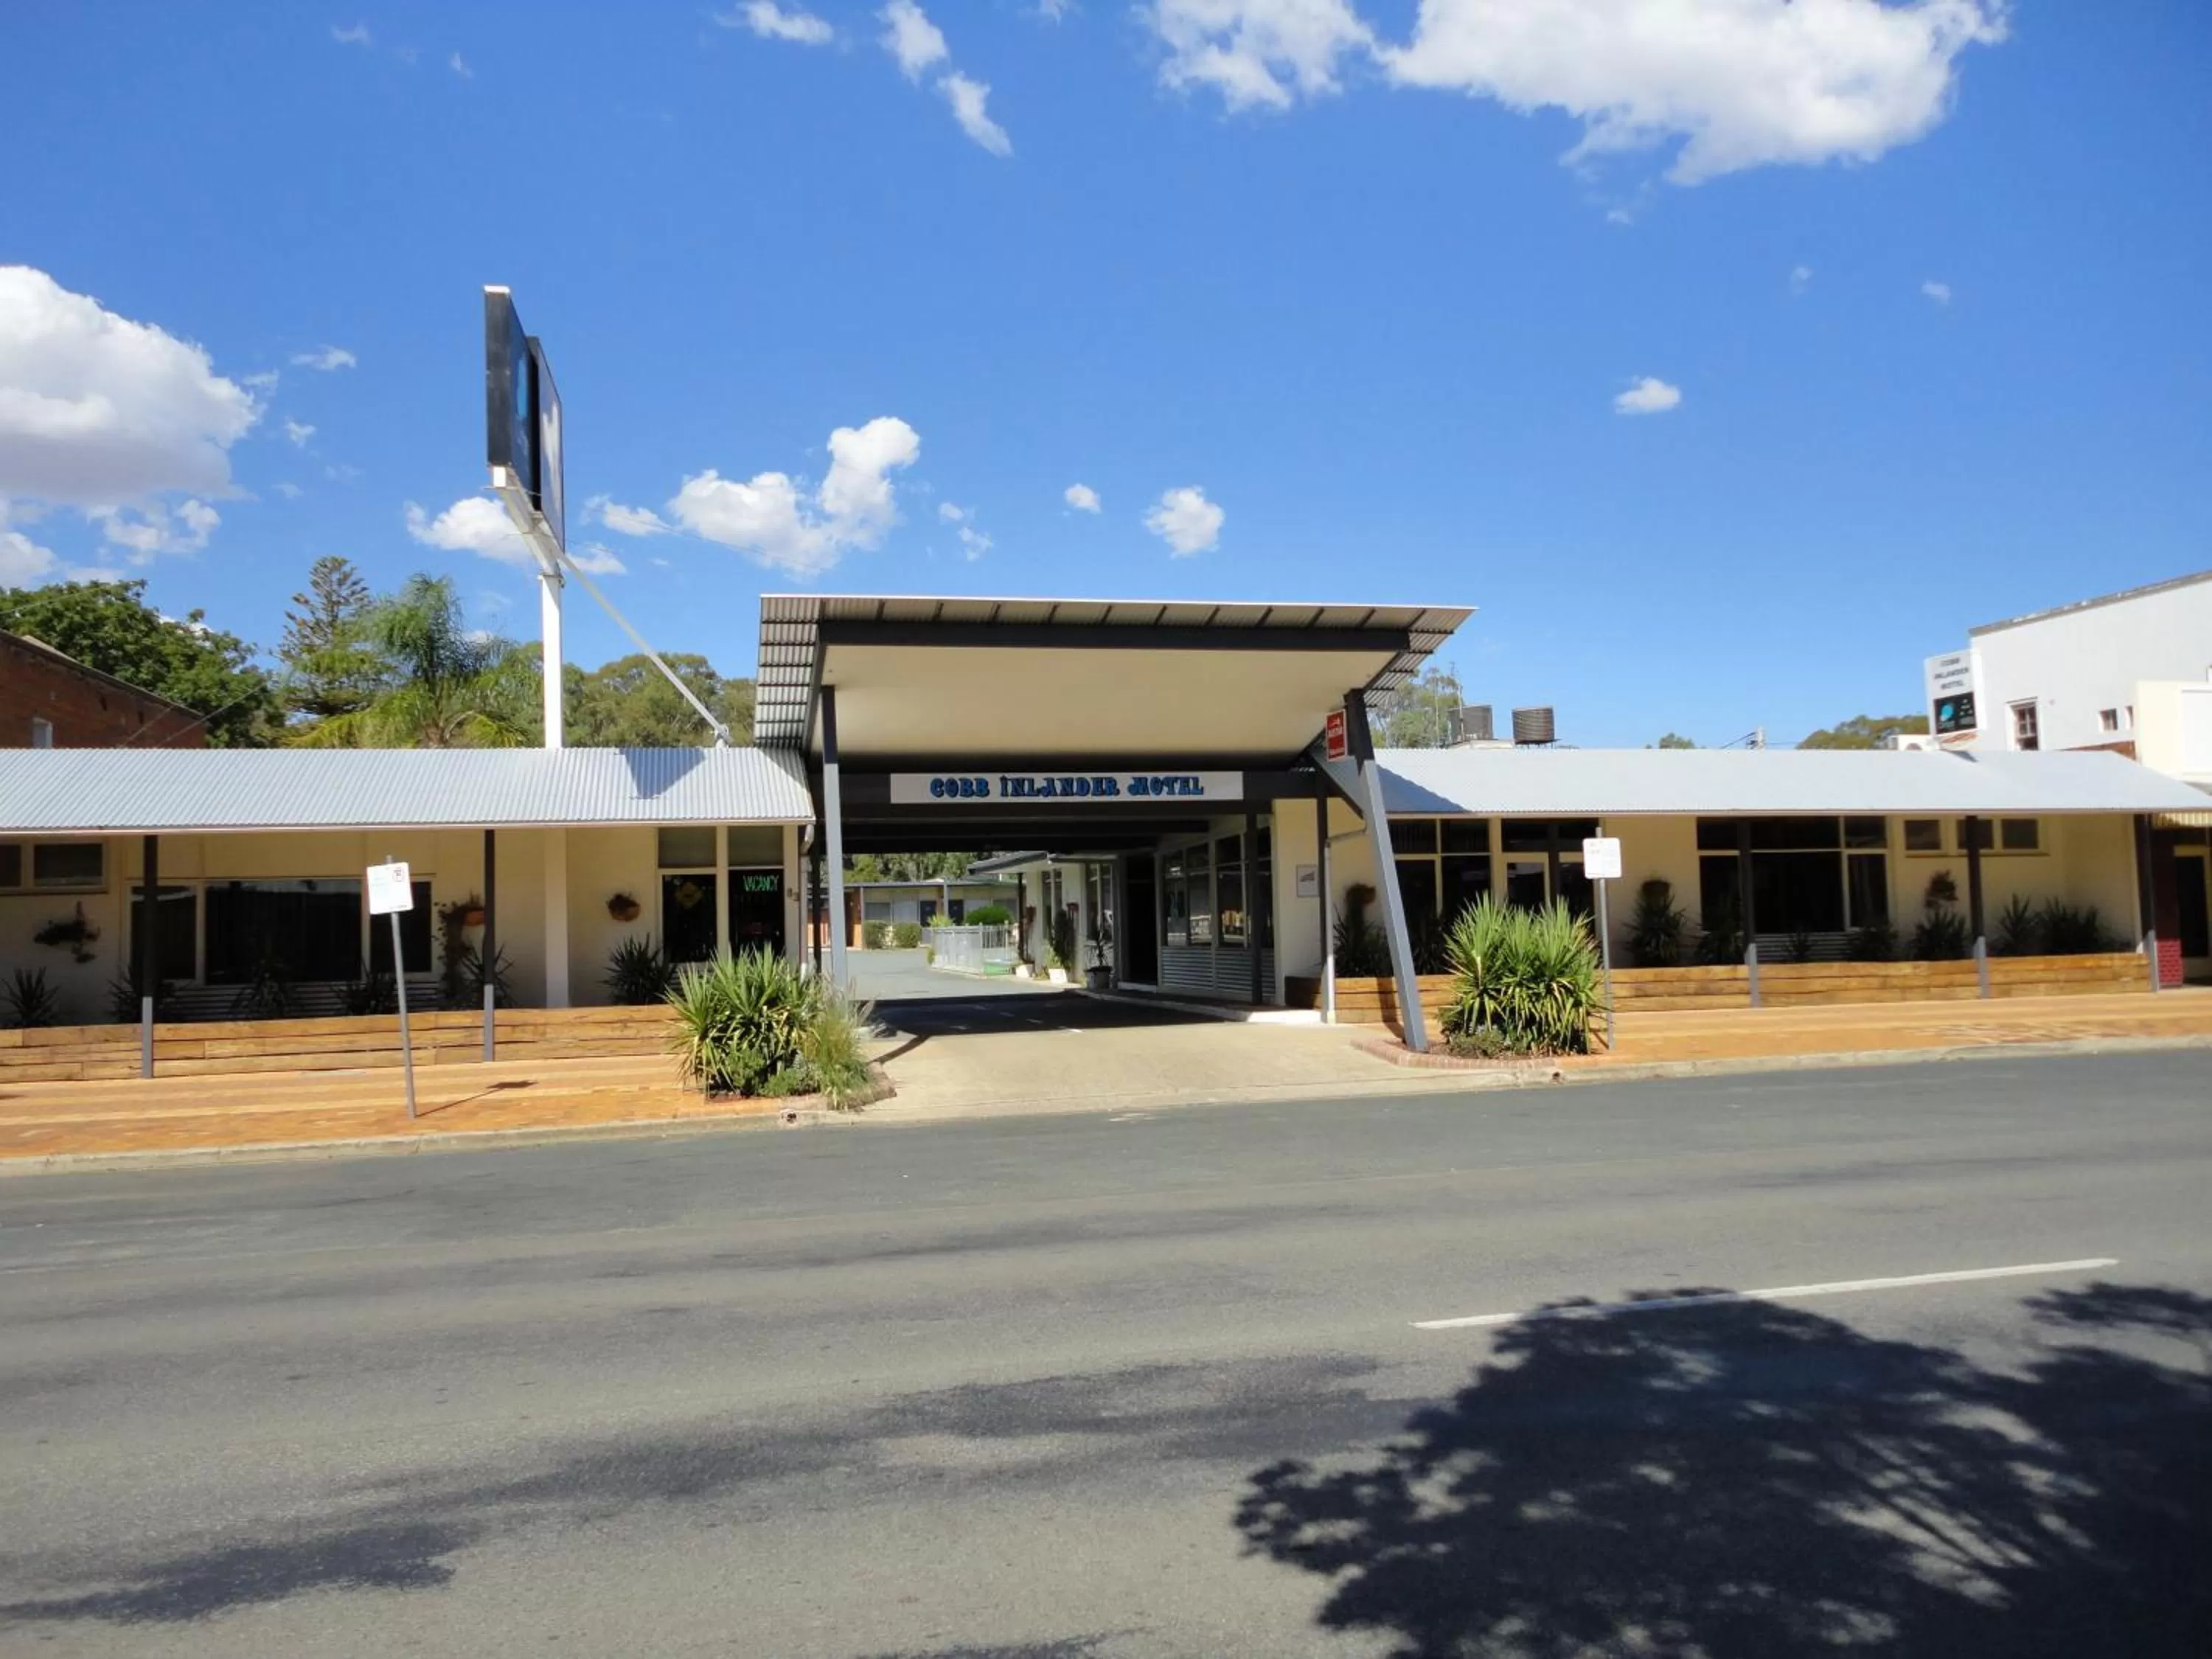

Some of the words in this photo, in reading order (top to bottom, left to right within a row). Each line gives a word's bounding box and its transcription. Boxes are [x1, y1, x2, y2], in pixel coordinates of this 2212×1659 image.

[931, 778, 990, 798] COBB
[1001, 775, 1120, 797] INLANDER
[1127, 776, 1203, 796] MOTEL
[743, 874, 779, 891] VACANCY
